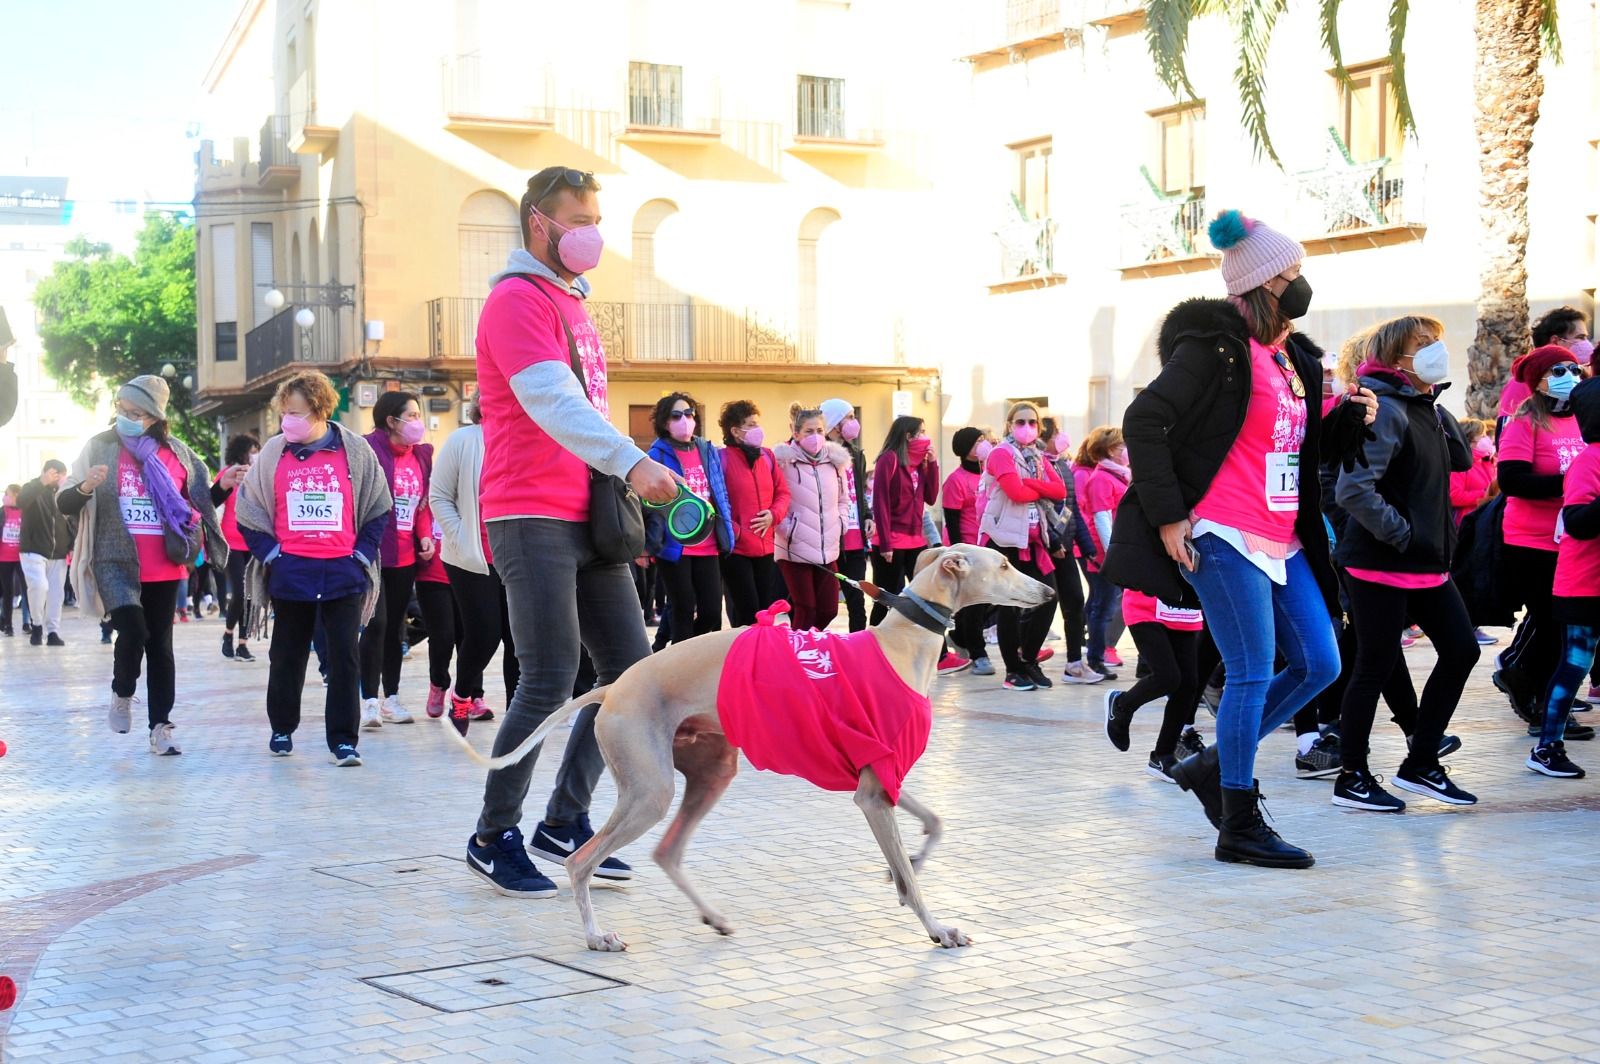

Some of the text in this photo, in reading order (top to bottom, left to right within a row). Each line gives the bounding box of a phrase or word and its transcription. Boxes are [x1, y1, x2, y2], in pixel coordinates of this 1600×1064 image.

[287, 466, 325, 479] AMACMEC
[124, 508, 158, 523] 3283
[297, 504, 333, 518] 3965
